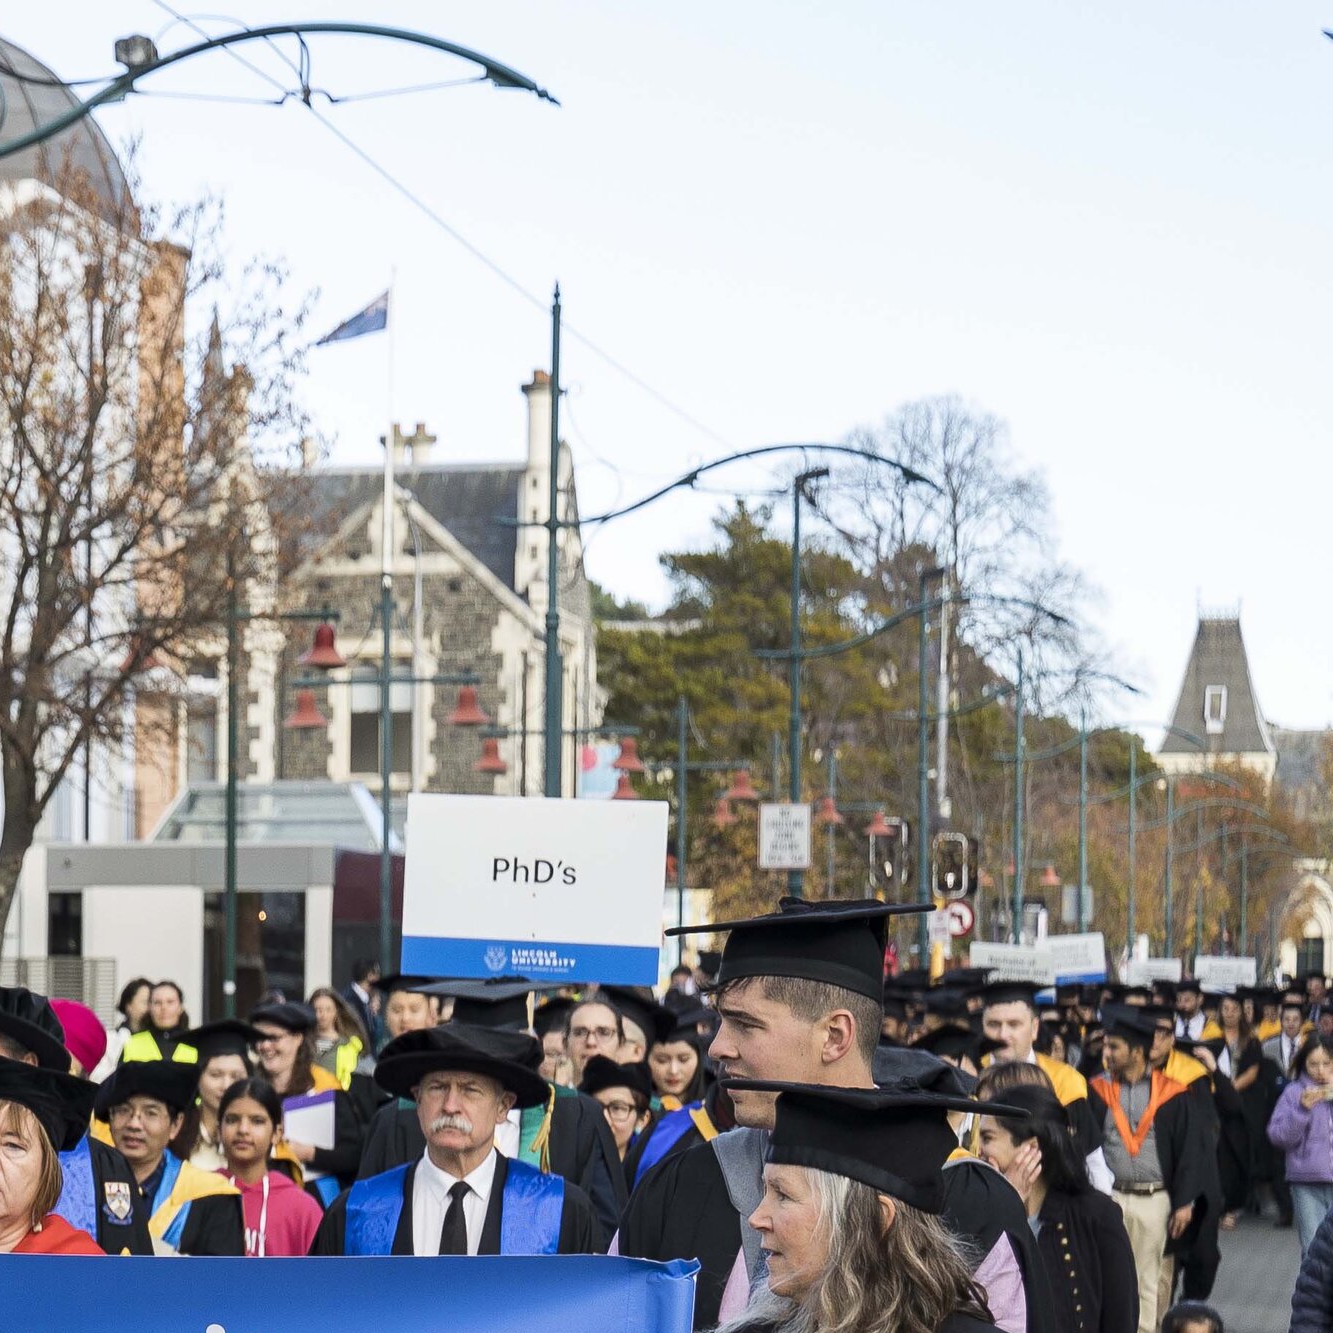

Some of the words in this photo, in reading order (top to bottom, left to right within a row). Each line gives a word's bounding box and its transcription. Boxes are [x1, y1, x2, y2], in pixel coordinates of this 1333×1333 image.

[493, 857, 577, 885] PhD's
[512, 948, 556, 958] LINCOLN
[512, 957, 575, 967] UNIVERSITY
